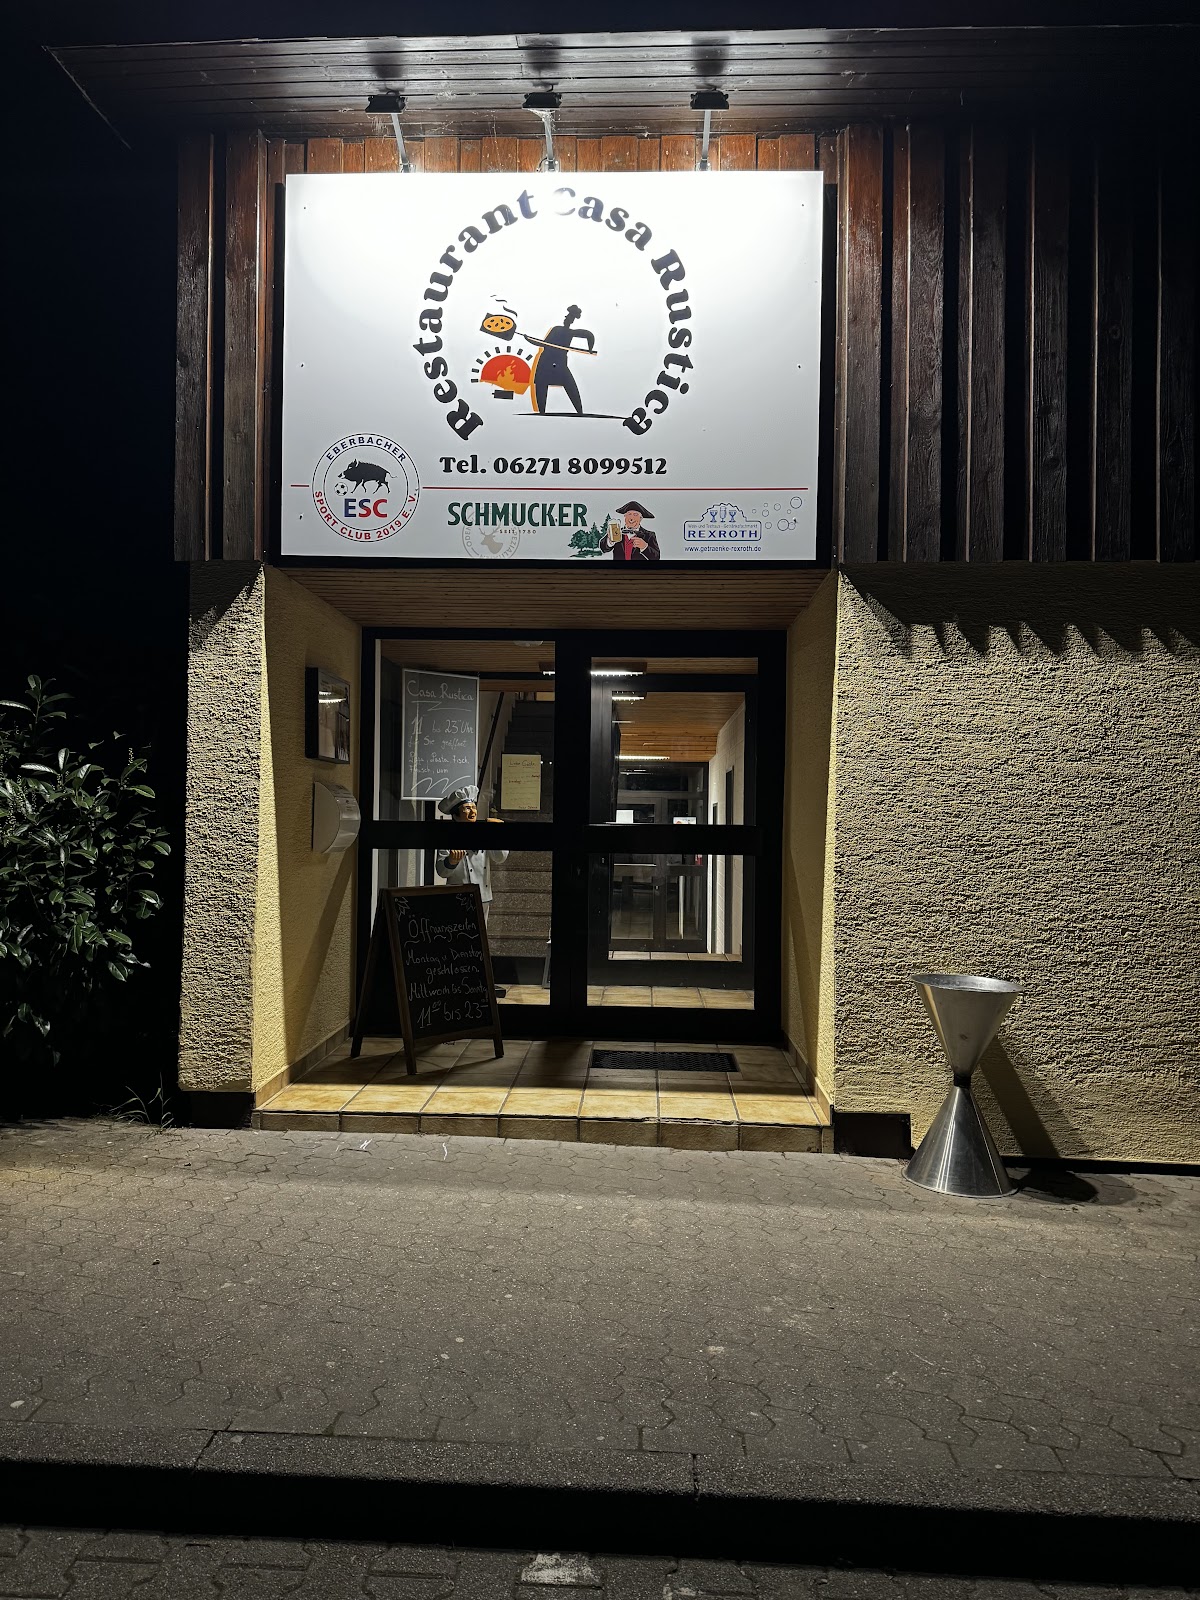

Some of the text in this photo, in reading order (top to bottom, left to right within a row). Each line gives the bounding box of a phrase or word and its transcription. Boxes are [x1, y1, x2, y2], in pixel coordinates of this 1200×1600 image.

[413, 187, 693, 442] Restaurant Casa Rustica
[326, 436, 407, 462] EBERBACHER
[440, 456, 667, 476] Tel. 06271 8099512
[315, 491, 338, 527] SPORT
[340, 526, 371, 540] CLUB
[376, 520, 402, 539] 2019
[344, 498, 388, 518] ESC
[447, 502, 588, 527] SCHMUCKER
[688, 530, 758, 539] REXROTH
[684, 545, 762, 554] www.getraenke-rexroth.de
[407, 680, 475, 701] Casa Rustica
[408, 914, 477, 943] Öffnungszeiten
[405, 949, 442, 968] Montag
[409, 982, 450, 1002] Mittwoch
[451, 983, 462, 995] bis
[443, 1002, 462, 1021] bis
